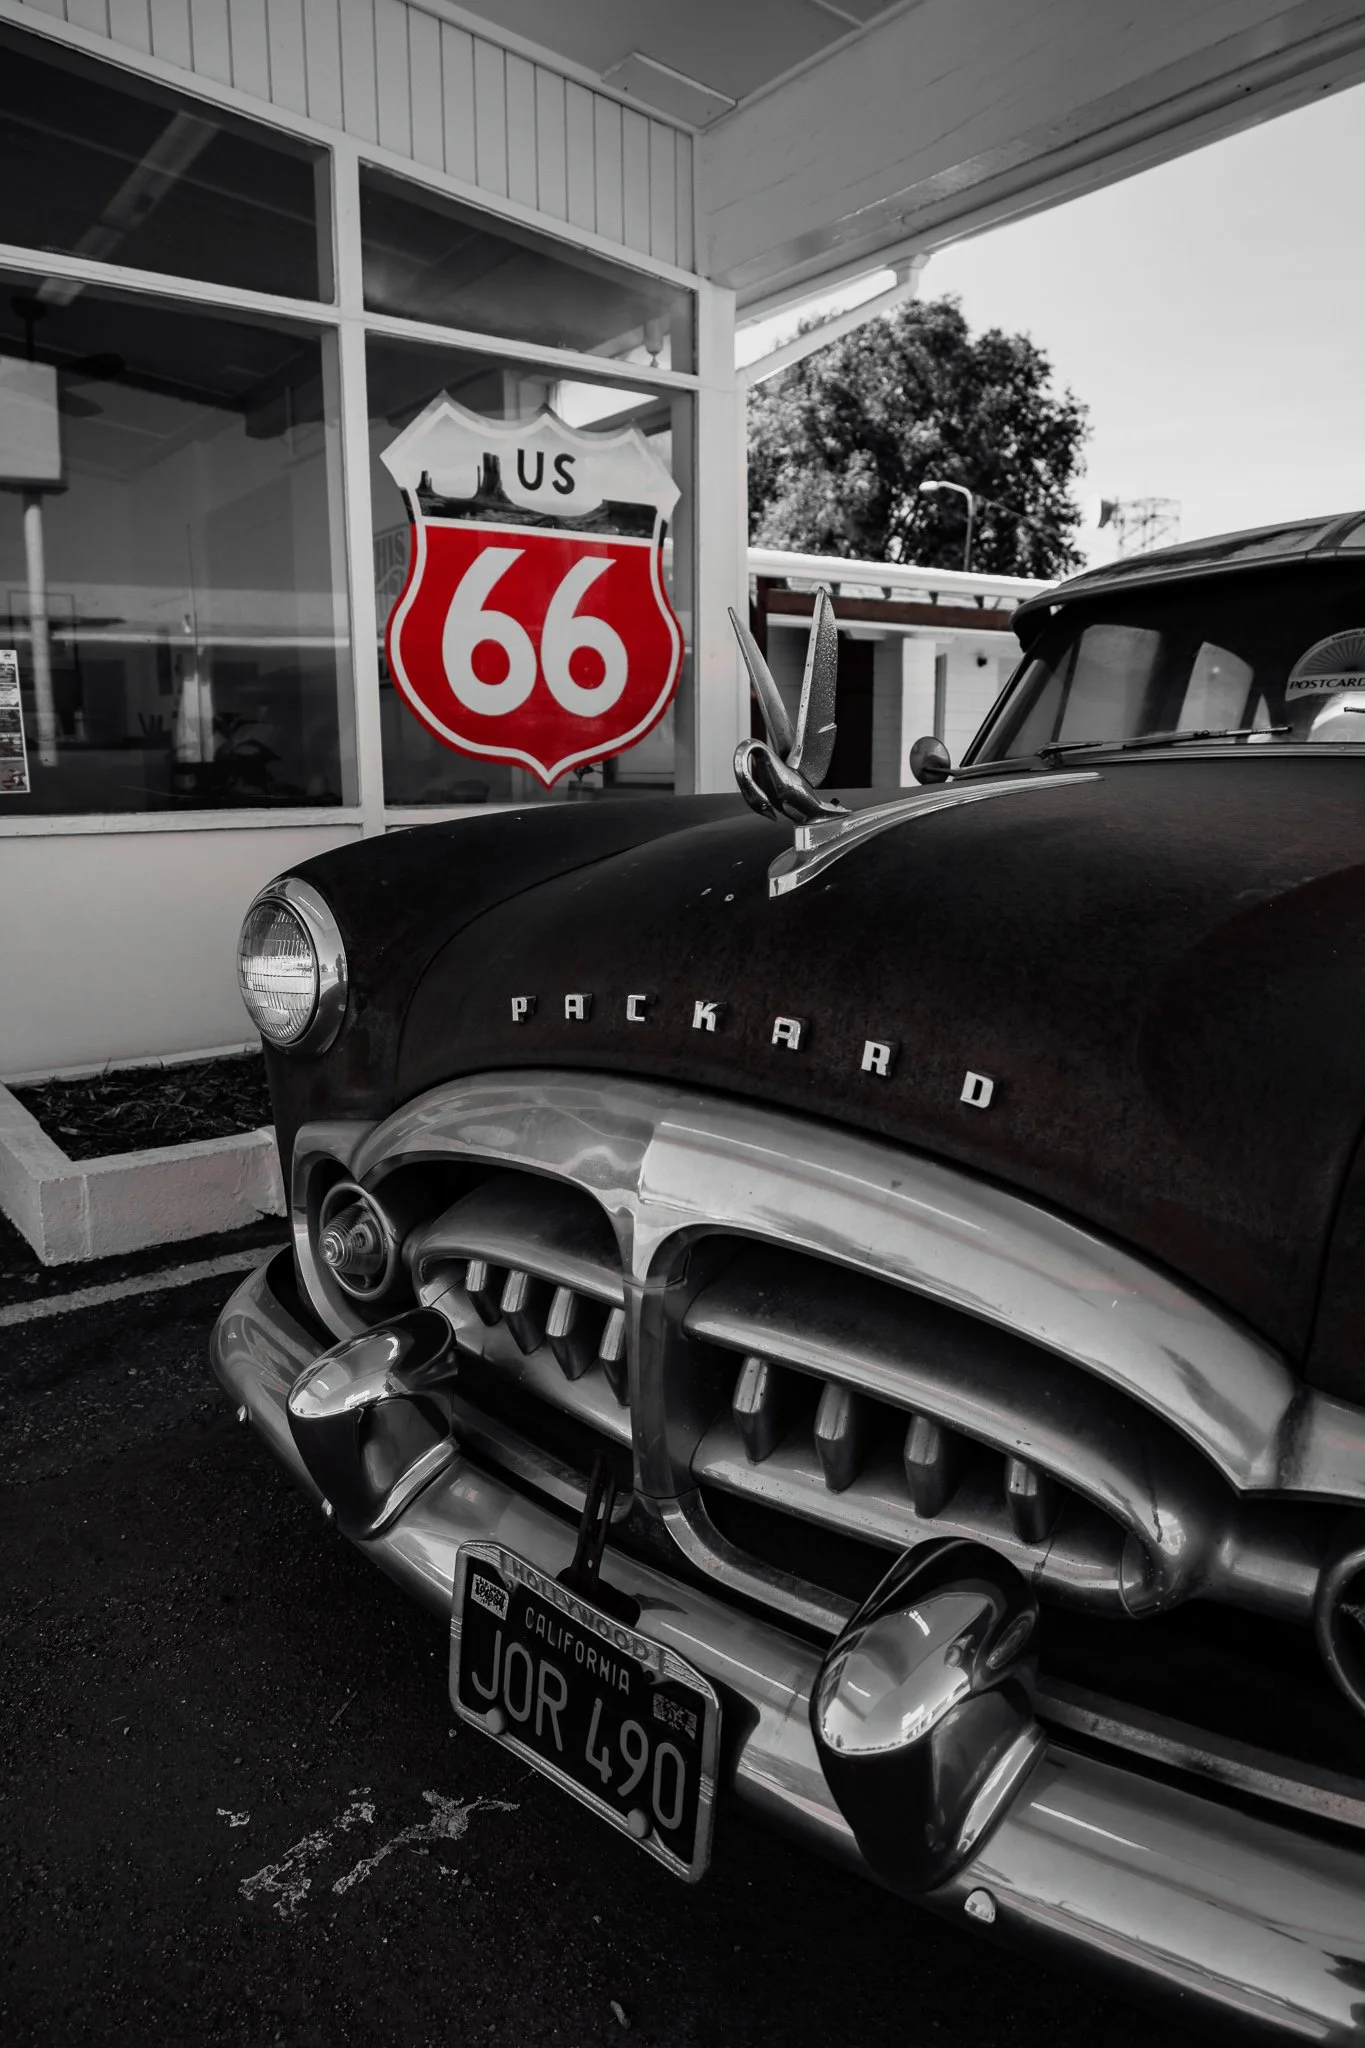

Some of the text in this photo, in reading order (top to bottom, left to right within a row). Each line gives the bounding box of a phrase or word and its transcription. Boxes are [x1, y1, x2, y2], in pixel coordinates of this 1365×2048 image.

[516, 448, 577, 495] US
[442, 546, 629, 718] 66
[511, 993, 997, 1109] PACKARD
[512, 1559, 650, 1662] HOLLYWOOD
[525, 1606, 630, 1696] CALIFORNIA
[471, 1630, 686, 1830] JOR 490
